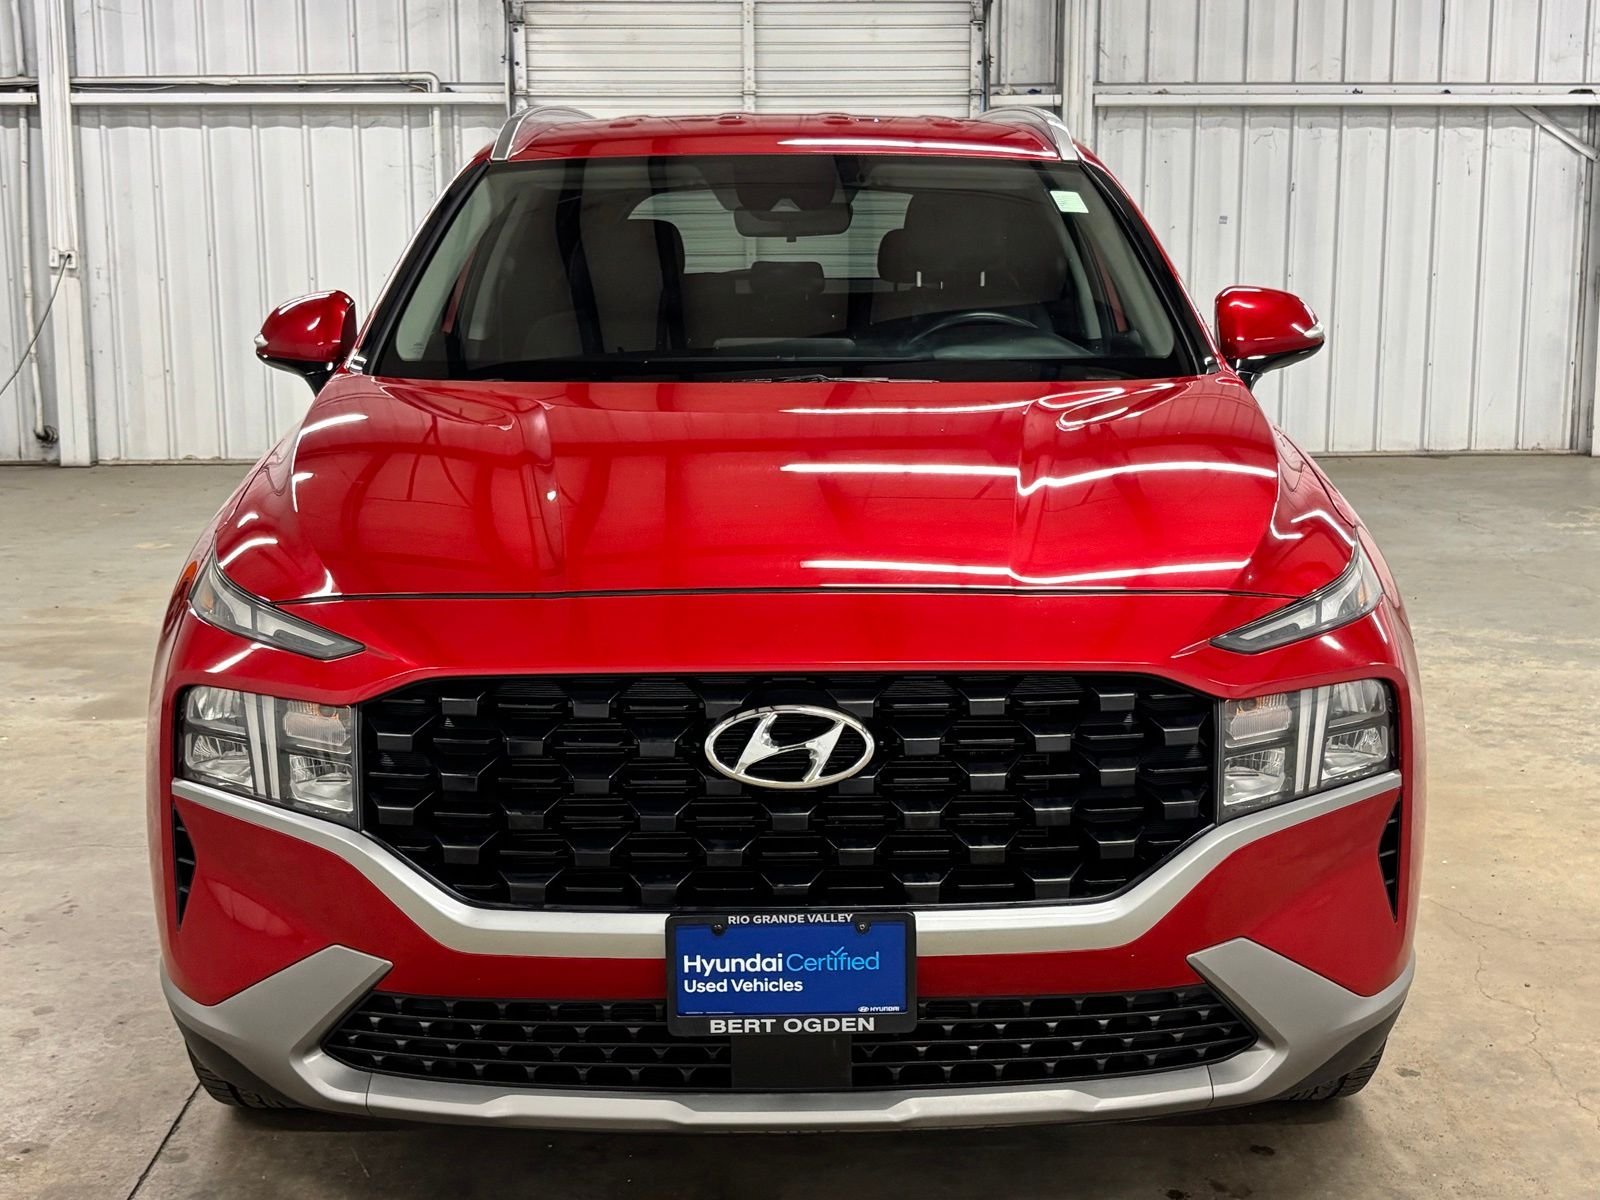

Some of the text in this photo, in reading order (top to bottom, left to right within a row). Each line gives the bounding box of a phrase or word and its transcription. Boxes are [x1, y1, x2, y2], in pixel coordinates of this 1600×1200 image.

[728, 914, 853, 924] RIO GRANDE VALLEY
[683, 946, 880, 976] Hyundai Certified
[684, 978, 803, 993] Used Vehicles
[710, 1017, 875, 1034] BERT OGDEN
